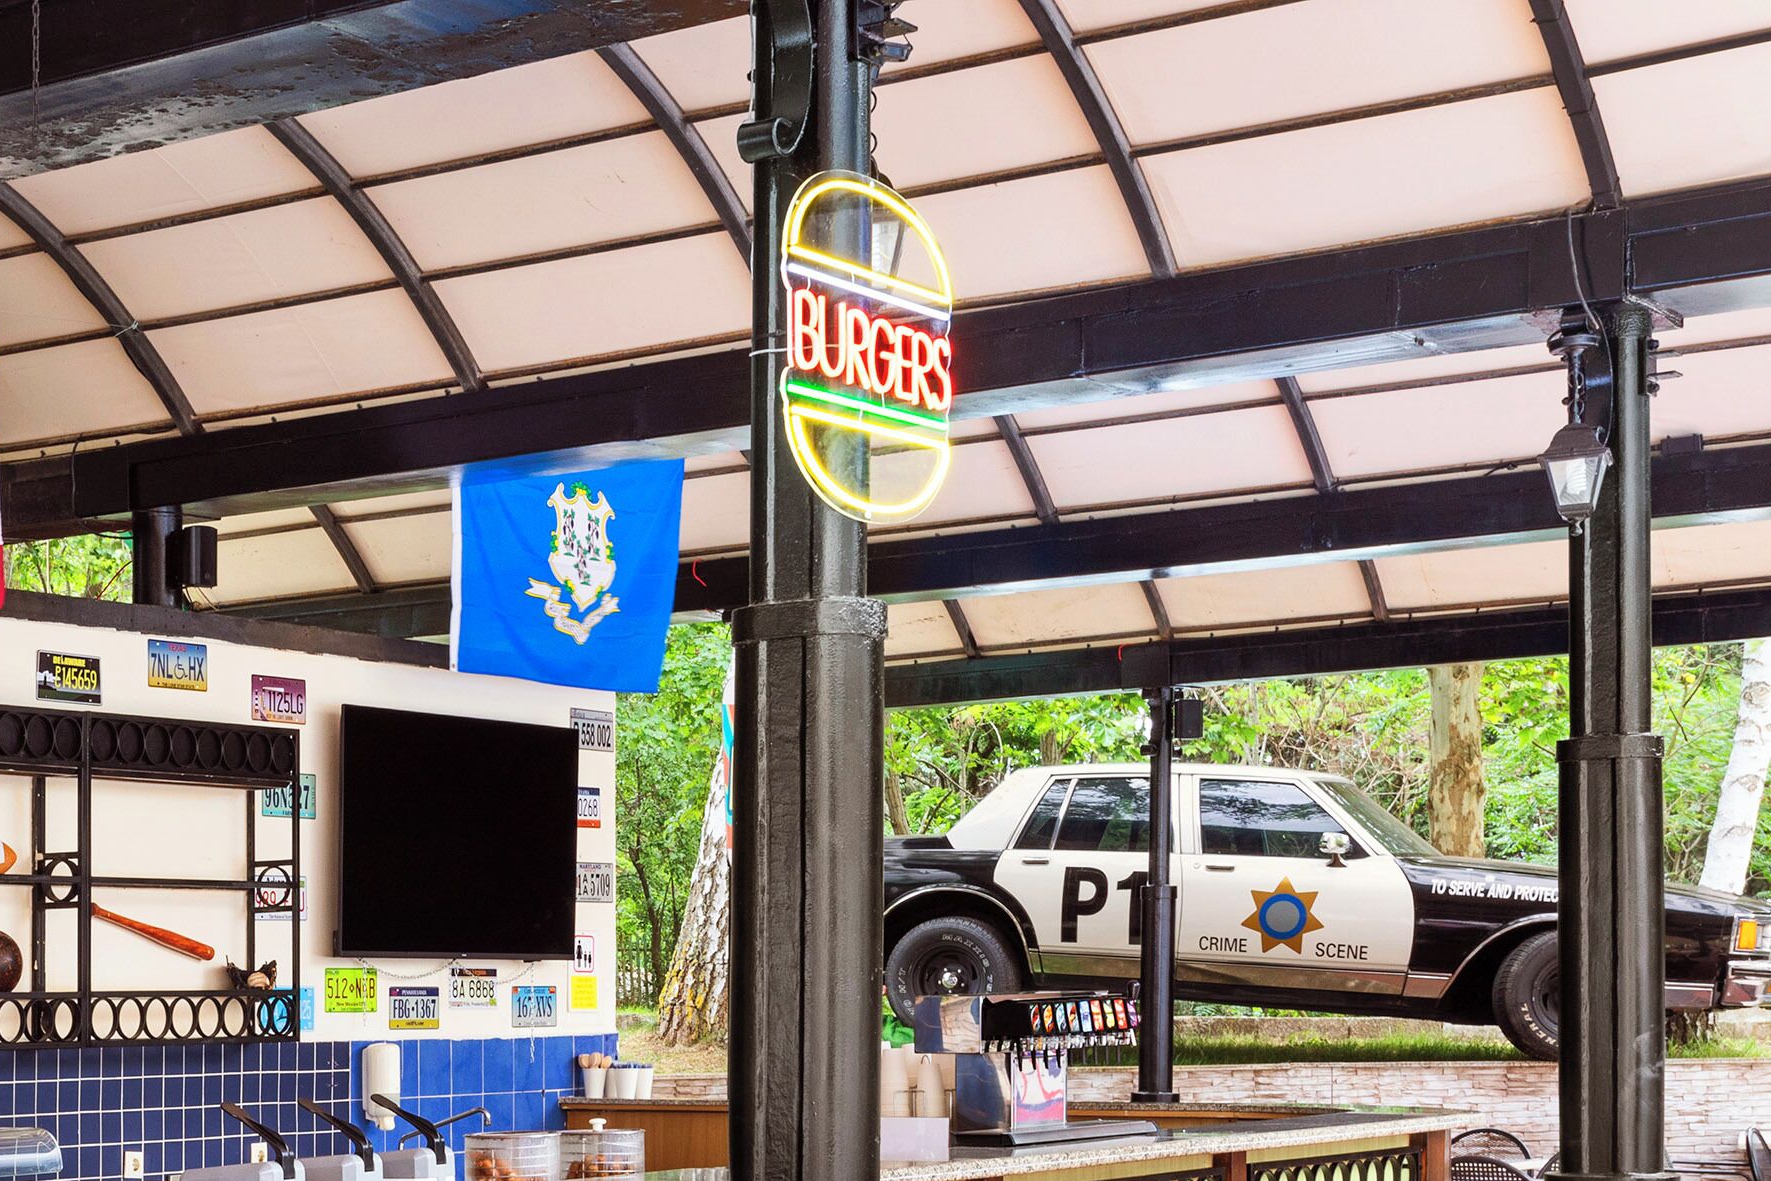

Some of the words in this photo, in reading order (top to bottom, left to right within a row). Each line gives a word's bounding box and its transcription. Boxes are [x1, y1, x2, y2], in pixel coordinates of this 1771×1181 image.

[794, 288, 951, 411] BURGERS
[1431, 879, 1447, 895] TO
[1448, 880, 1486, 898] SERVE
[1487, 882, 1513, 899] AND
[1513, 885, 1559, 903] PROTEC
[1198, 935, 1248, 953] CRIME
[1315, 942, 1369, 961] SCENE
